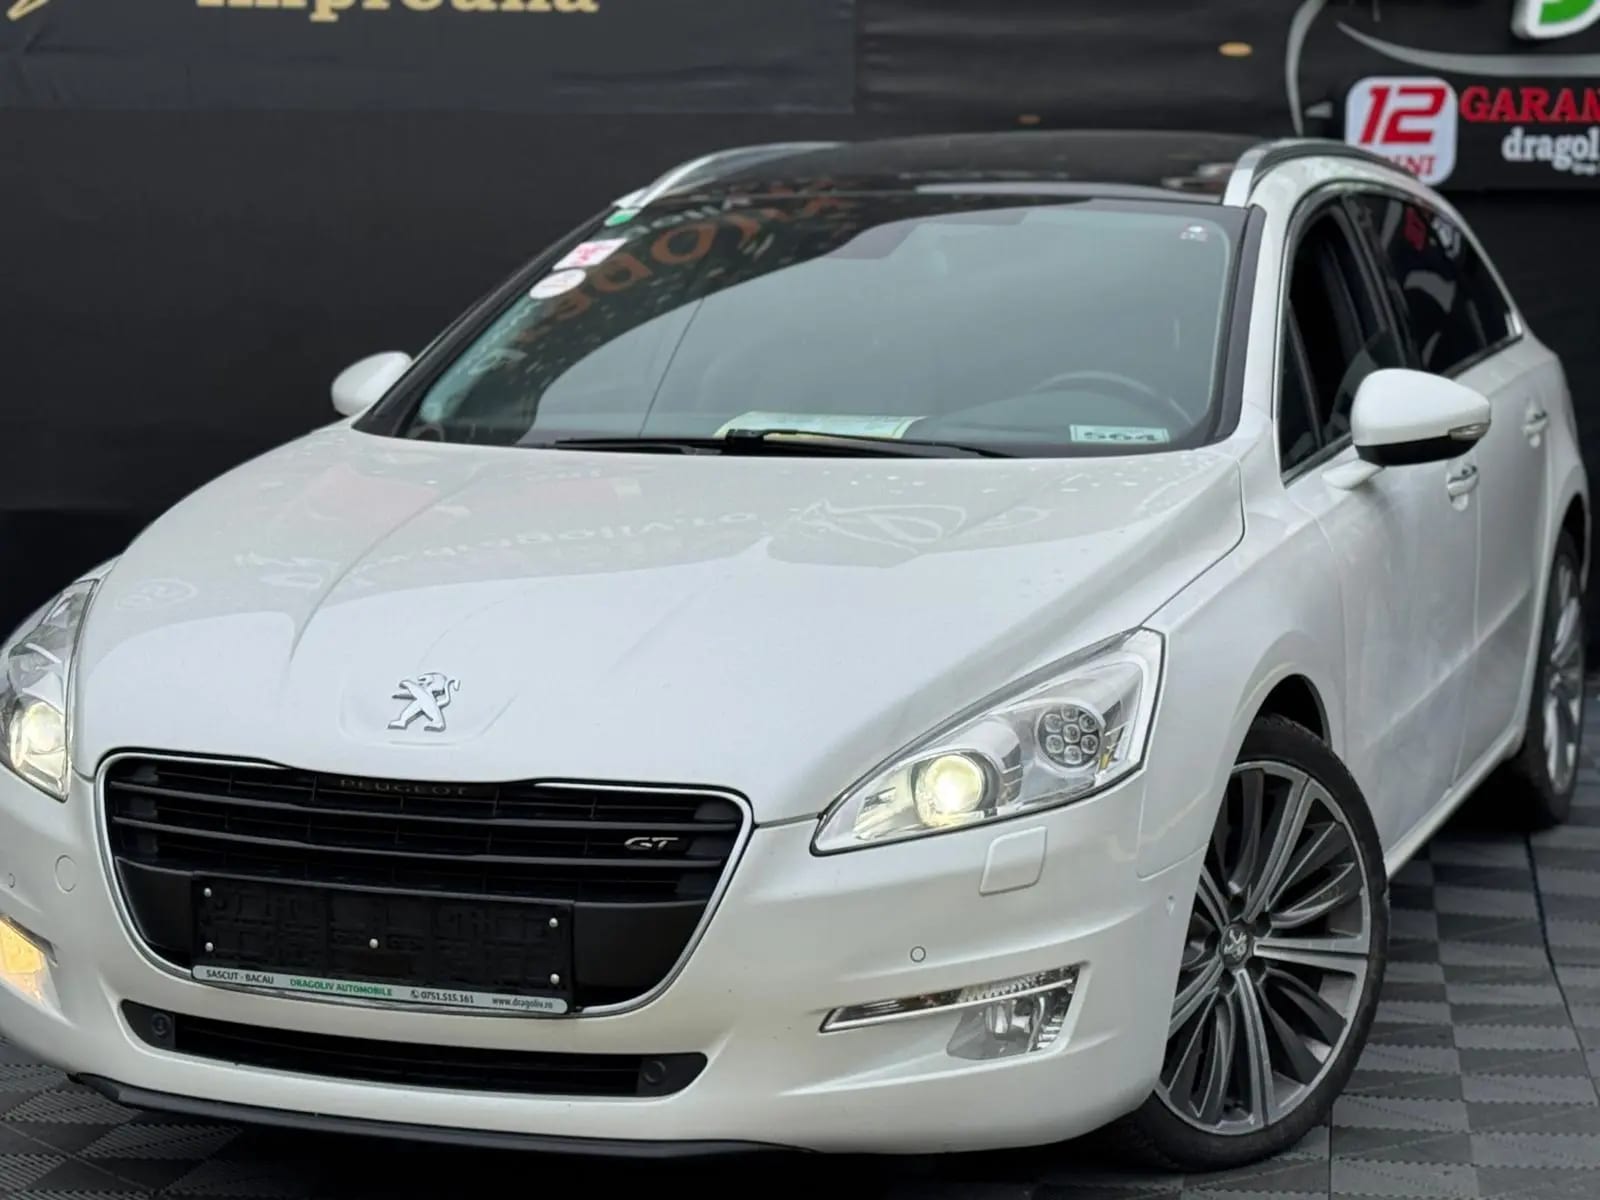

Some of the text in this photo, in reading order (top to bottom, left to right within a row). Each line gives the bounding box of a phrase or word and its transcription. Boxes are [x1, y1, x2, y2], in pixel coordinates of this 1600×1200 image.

[1360, 85, 1447, 144] 12
[624, 836, 679, 850] GT
[206, 968, 240, 981] SASCUT
[289, 977, 335, 992] DRAGOLIV
[336, 983, 393, 997] AUTOMOBILE
[420, 990, 475, 1005] 0751.515.161
[492, 997, 553, 1010] www.dragoliv.ro
